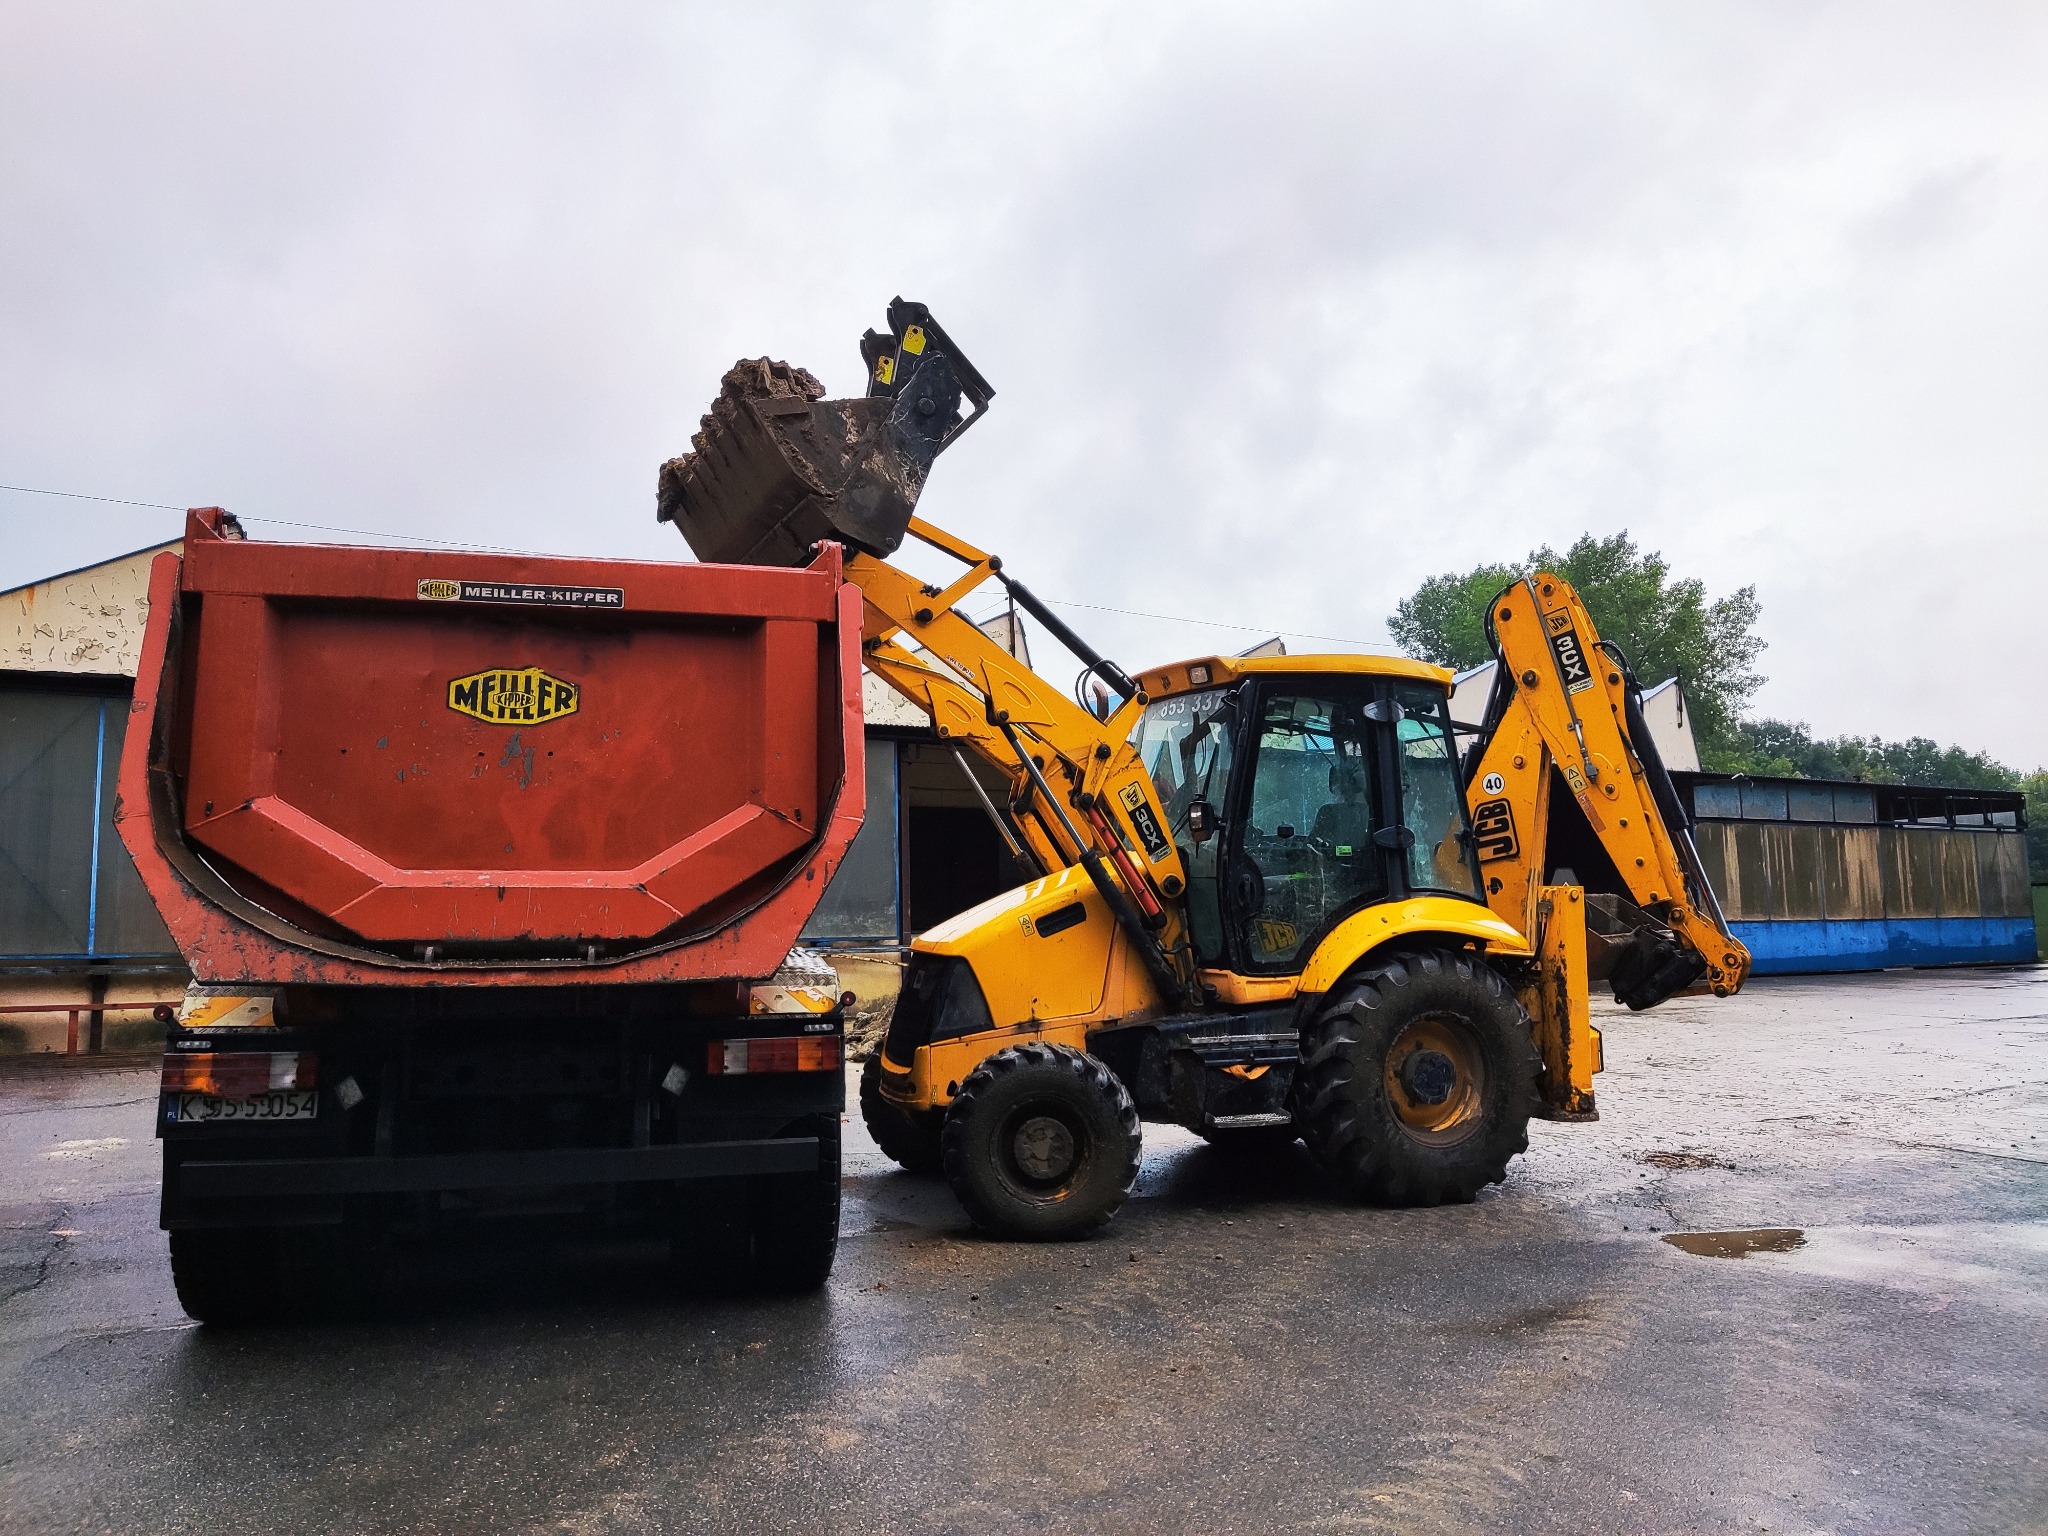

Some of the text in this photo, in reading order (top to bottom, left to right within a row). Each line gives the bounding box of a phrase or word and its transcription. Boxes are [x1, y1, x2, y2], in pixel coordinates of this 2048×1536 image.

[1549, 616, 1569, 631] JCB
[1556, 635, 1586, 680] 3CX
[454, 674, 574, 720] MEILLER
[496, 692, 532, 707] KIPPER
[1485, 777, 1502, 790] 40
[1135, 808, 1161, 849] 3CX
[1475, 802, 1513, 856] JCB
[167, 1111, 177, 1119] PL
